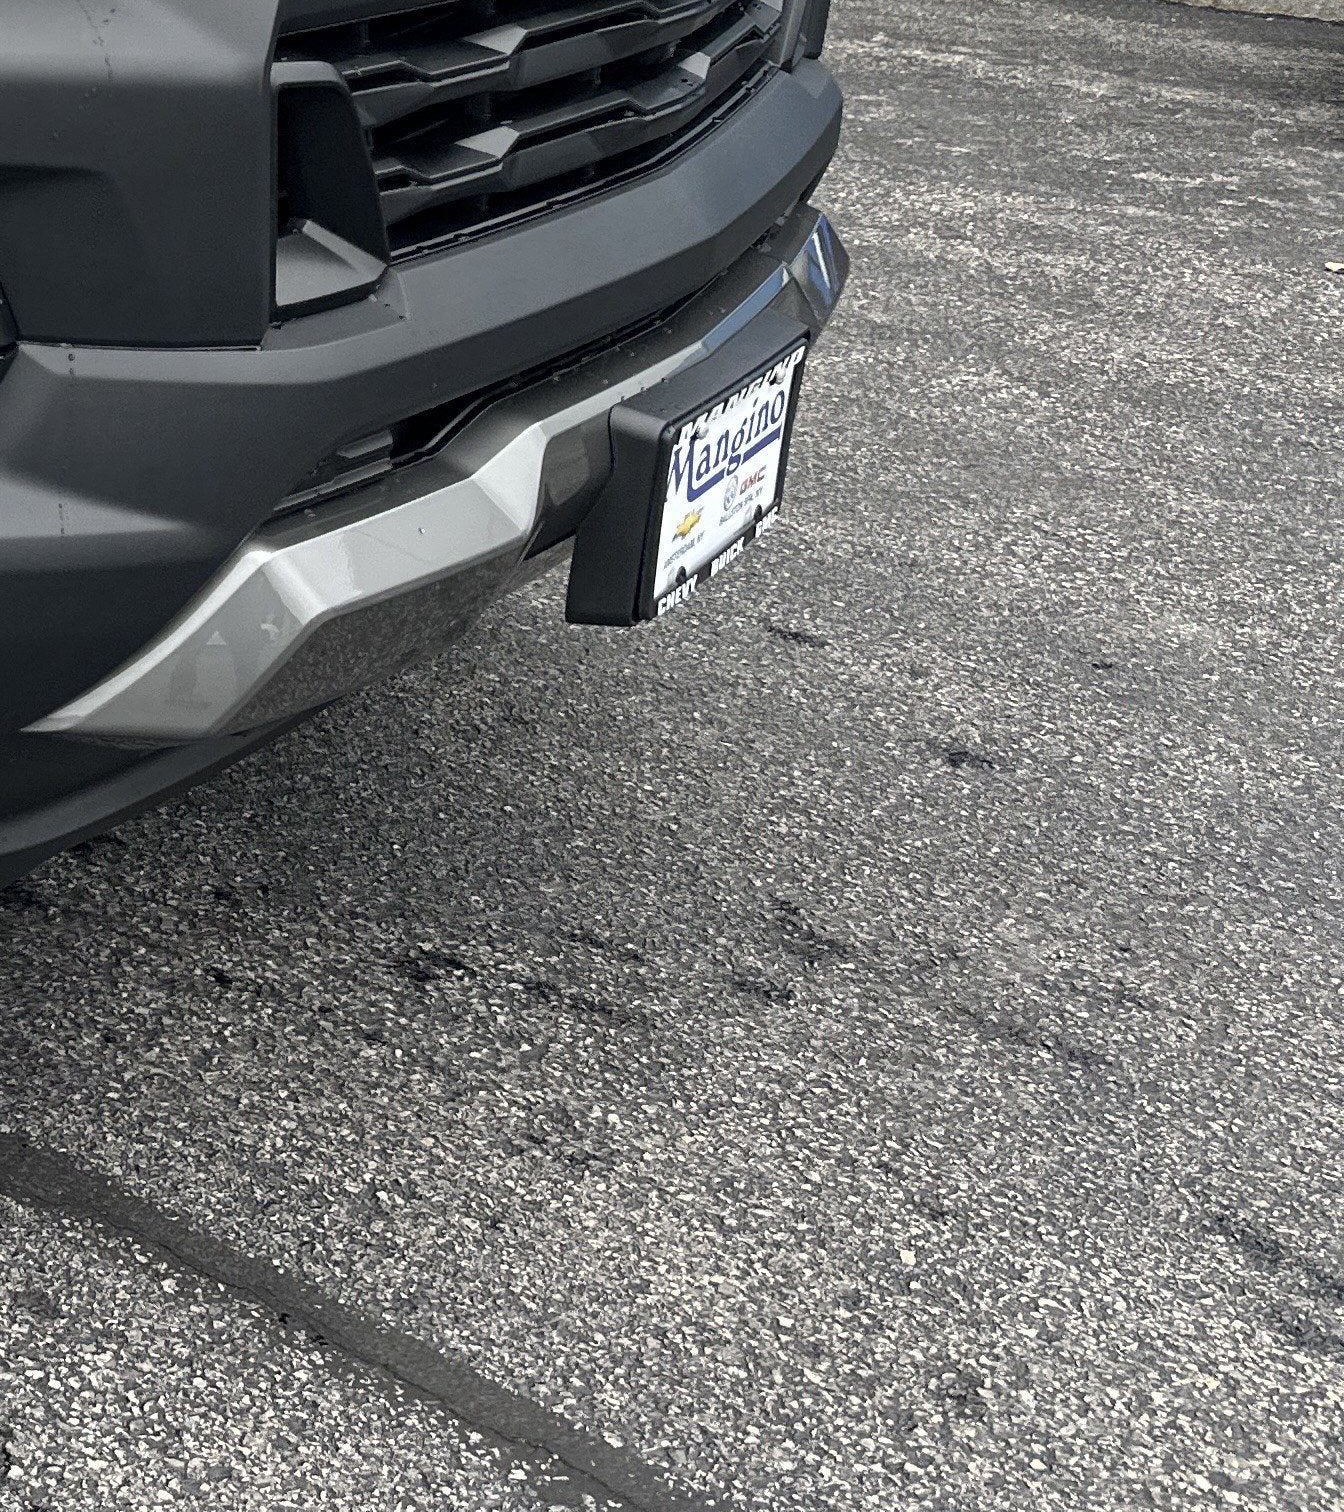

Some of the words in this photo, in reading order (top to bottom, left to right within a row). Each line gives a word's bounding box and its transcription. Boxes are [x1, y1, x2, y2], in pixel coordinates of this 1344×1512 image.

[666, 389, 786, 502] Mangino
[711, 536, 745, 577] BUICK
[657, 574, 699, 616] CHEVY
